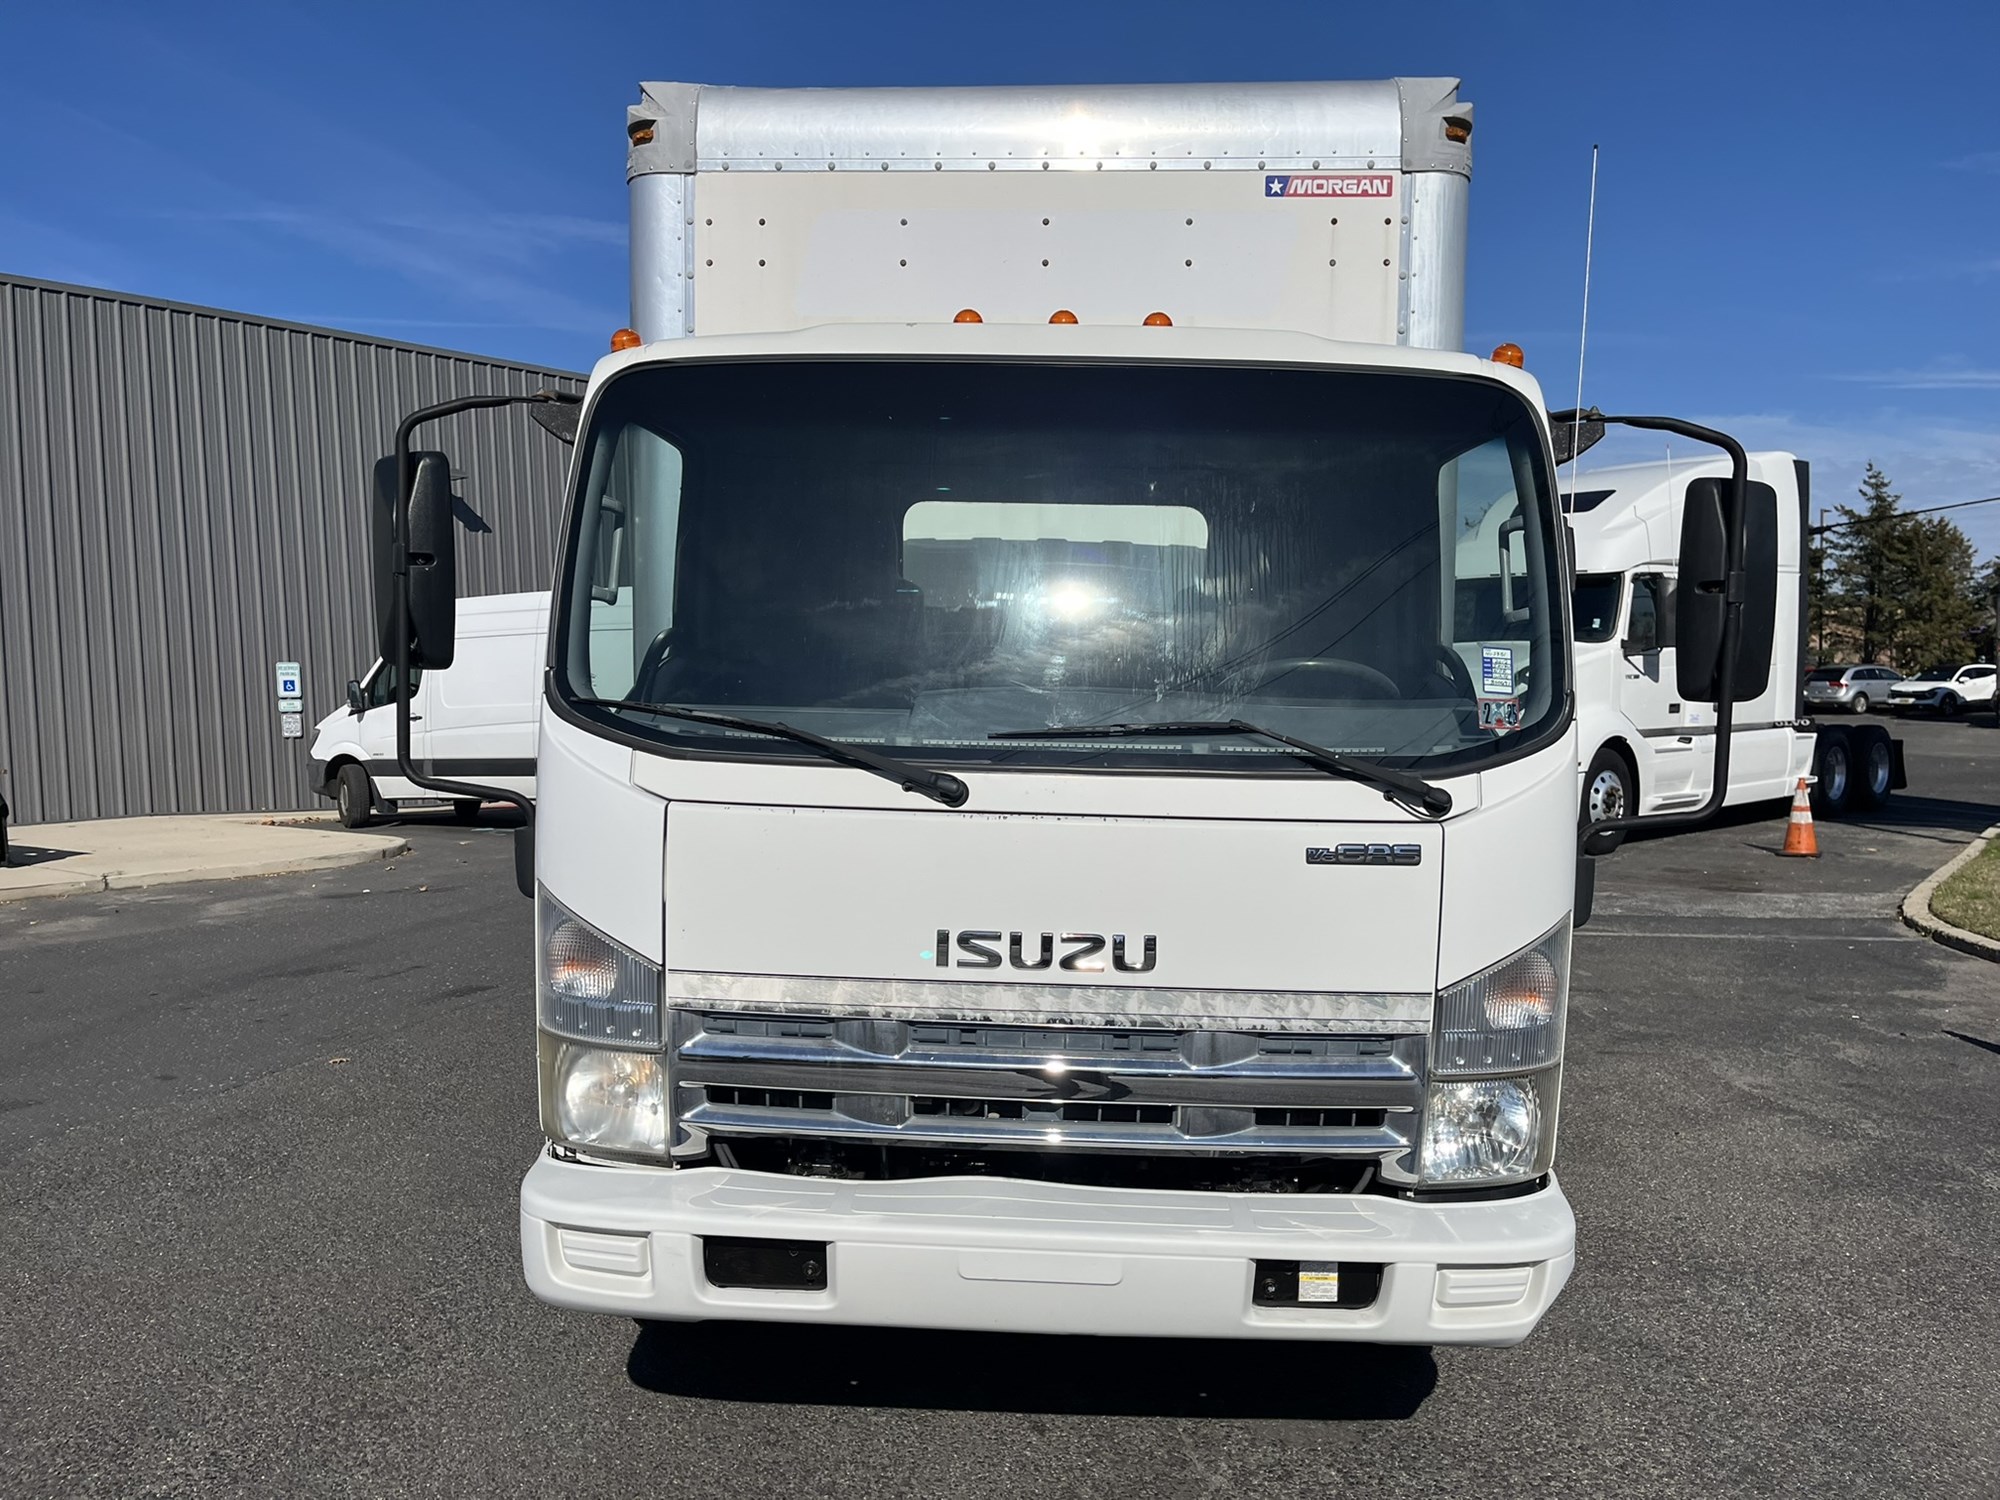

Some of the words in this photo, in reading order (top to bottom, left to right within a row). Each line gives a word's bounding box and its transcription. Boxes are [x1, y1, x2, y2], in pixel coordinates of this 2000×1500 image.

[1288, 178, 1388, 195] MORGAN
[1484, 702, 1491, 724] 2
[1774, 718, 1811, 727] OLVO
[936, 929, 1157, 973] ISUZU
